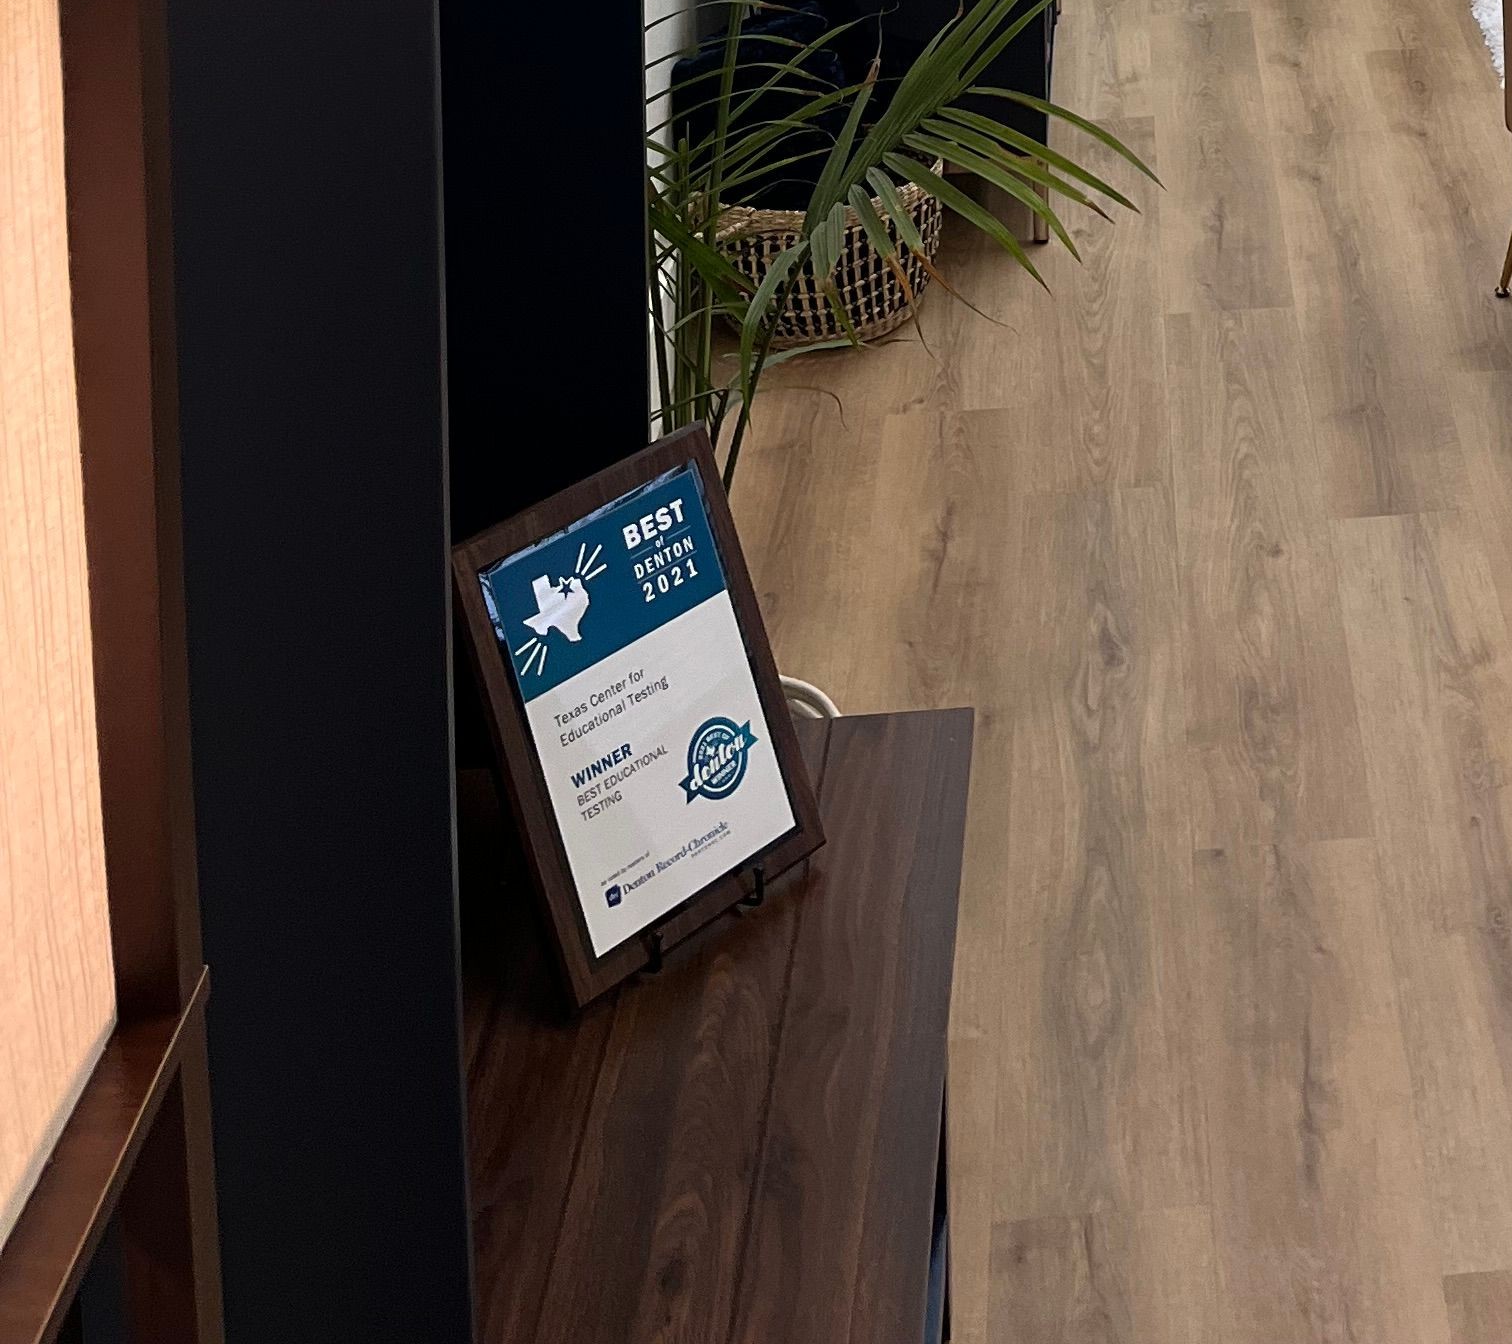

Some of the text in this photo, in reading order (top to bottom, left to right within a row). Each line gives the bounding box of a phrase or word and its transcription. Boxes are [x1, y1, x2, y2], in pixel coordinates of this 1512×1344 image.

[622, 498, 684, 550] BEST
[655, 535, 665, 548] of
[633, 535, 694, 579] DENTON
[643, 558, 698, 602] 2021
[553, 669, 644, 728] Texas Center for
[560, 675, 669, 747] Educational Testing
[570, 743, 633, 789] WINNER
[576, 744, 669, 806] BEST EDUCATIONAL
[690, 733, 745, 791] denton
[711, 760, 737, 784] WINNER
[581, 790, 622, 821] TESTING
[622, 821, 728, 895] Denton Record-Chronicle
